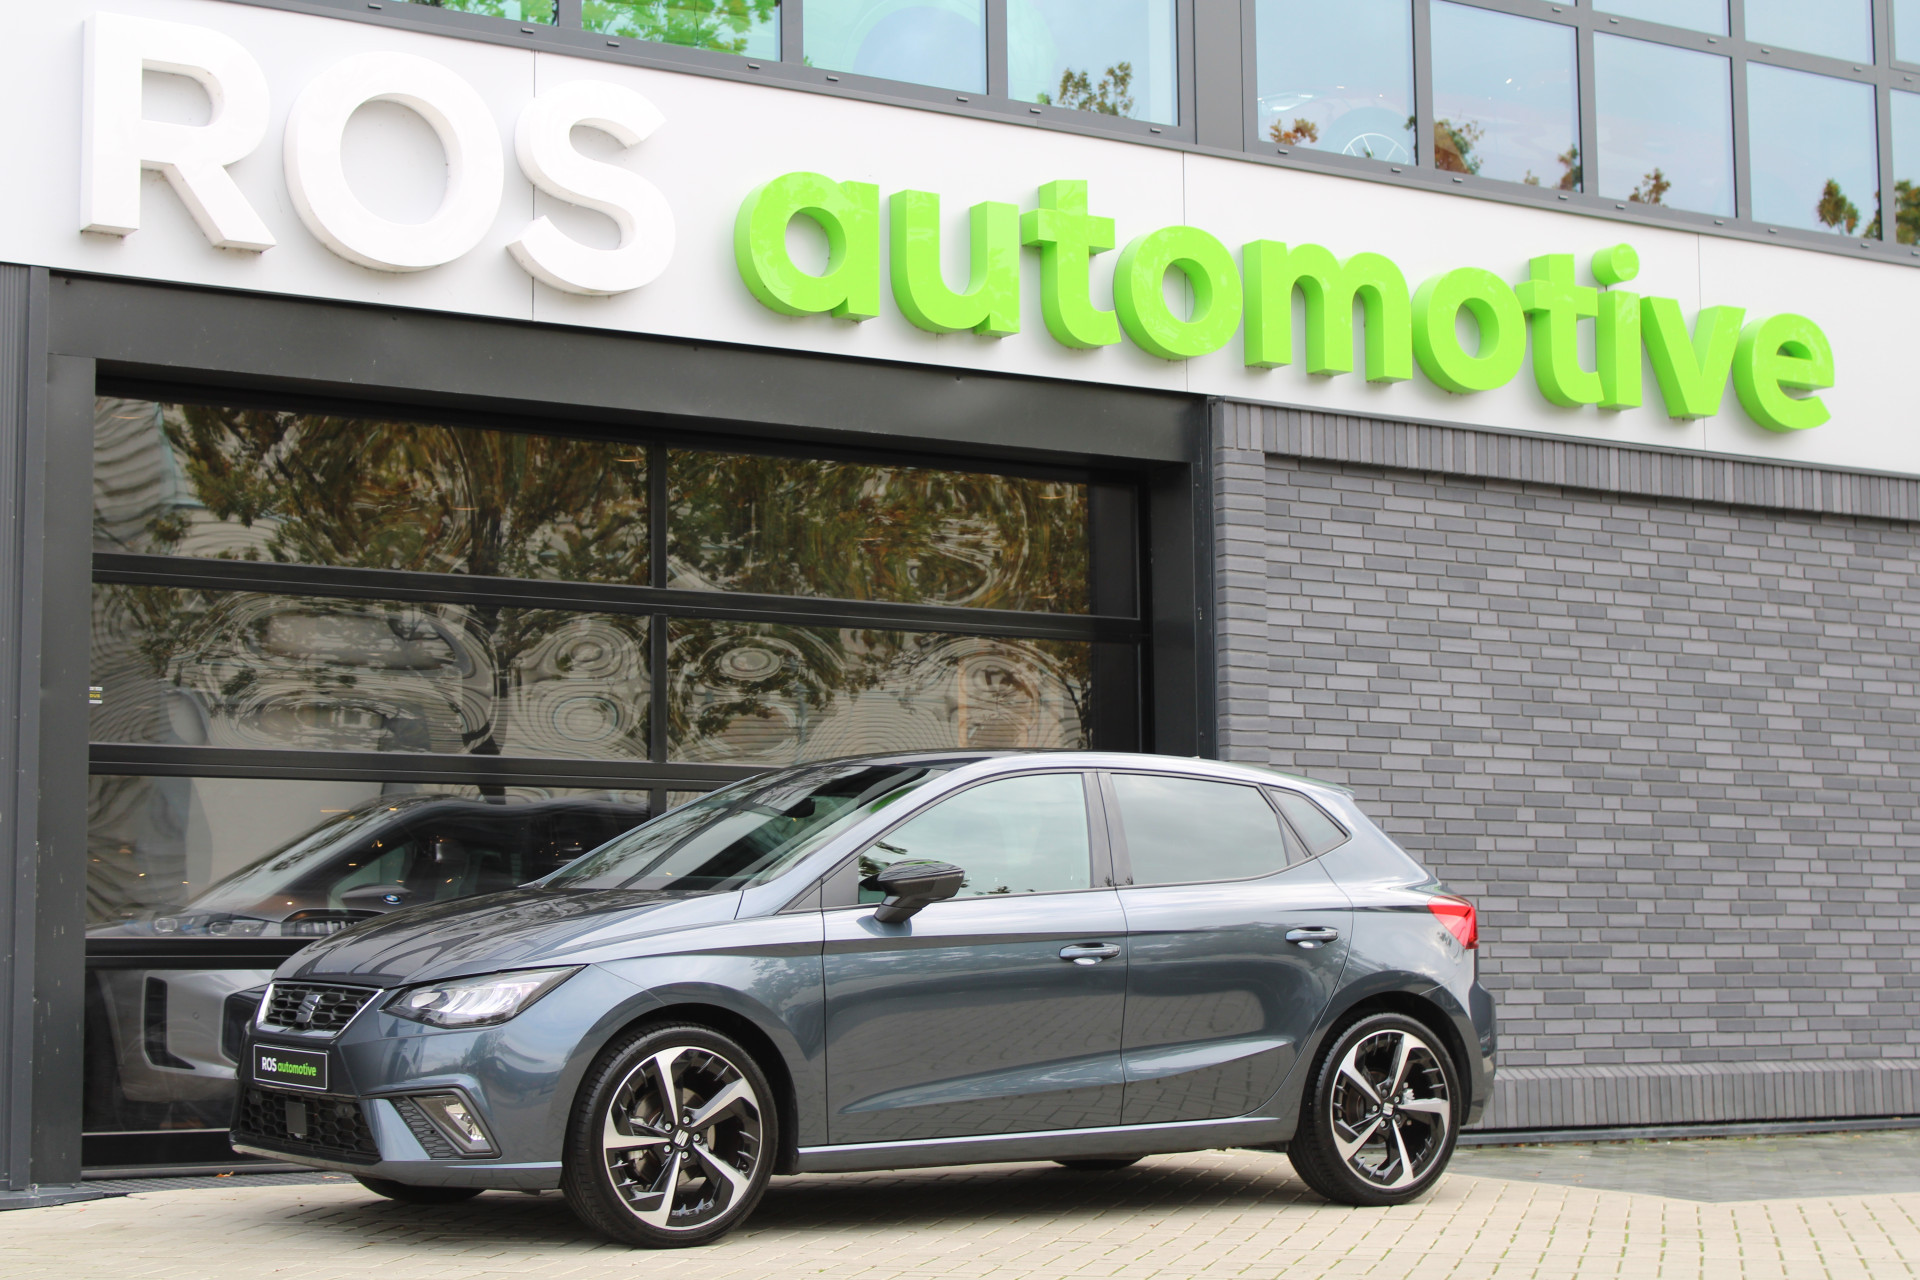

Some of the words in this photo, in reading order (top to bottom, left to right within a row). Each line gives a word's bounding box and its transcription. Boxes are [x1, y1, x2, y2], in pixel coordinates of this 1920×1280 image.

[80, 13, 676, 296] ROS
[734, 171, 1834, 432] automotive
[261, 1056, 277, 1072] ROS
[277, 1061, 317, 1076] automotive
